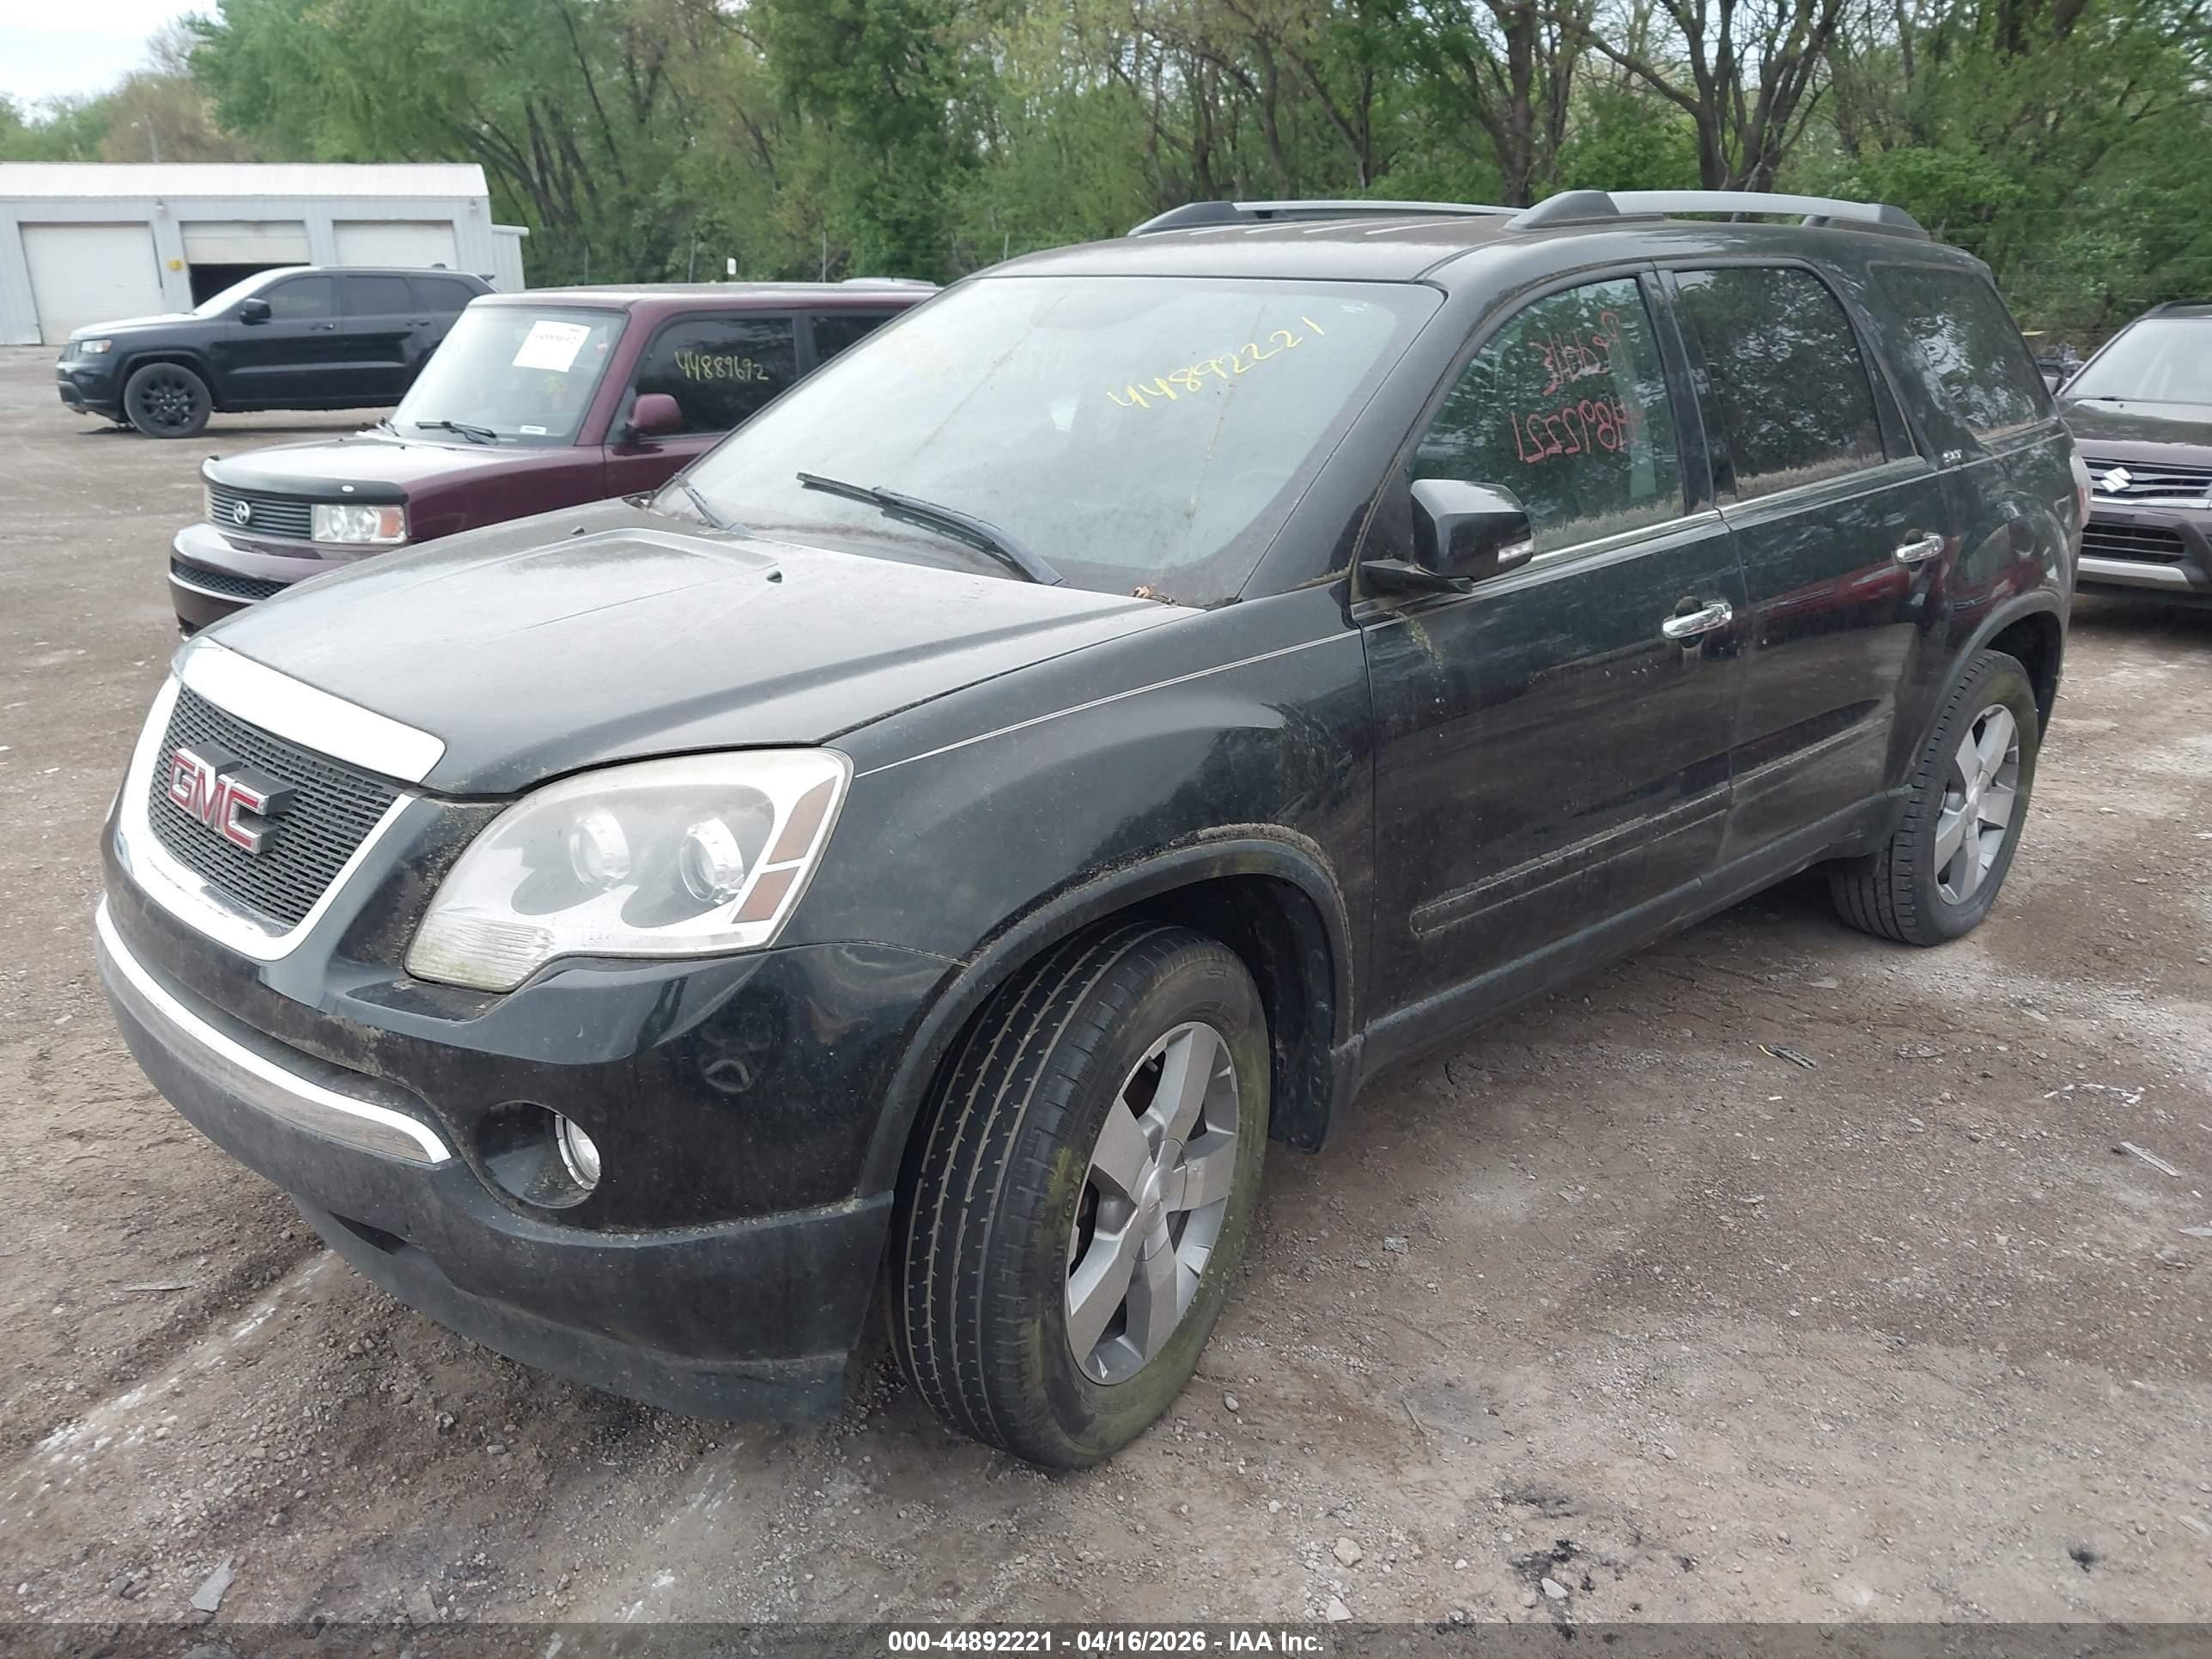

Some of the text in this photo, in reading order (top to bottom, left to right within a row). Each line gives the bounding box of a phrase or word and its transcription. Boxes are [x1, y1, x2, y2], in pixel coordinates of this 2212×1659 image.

[673, 350, 769, 381] 44889692
[1105, 315, 1325, 408] 44892221
[168, 747, 269, 854] GMC
